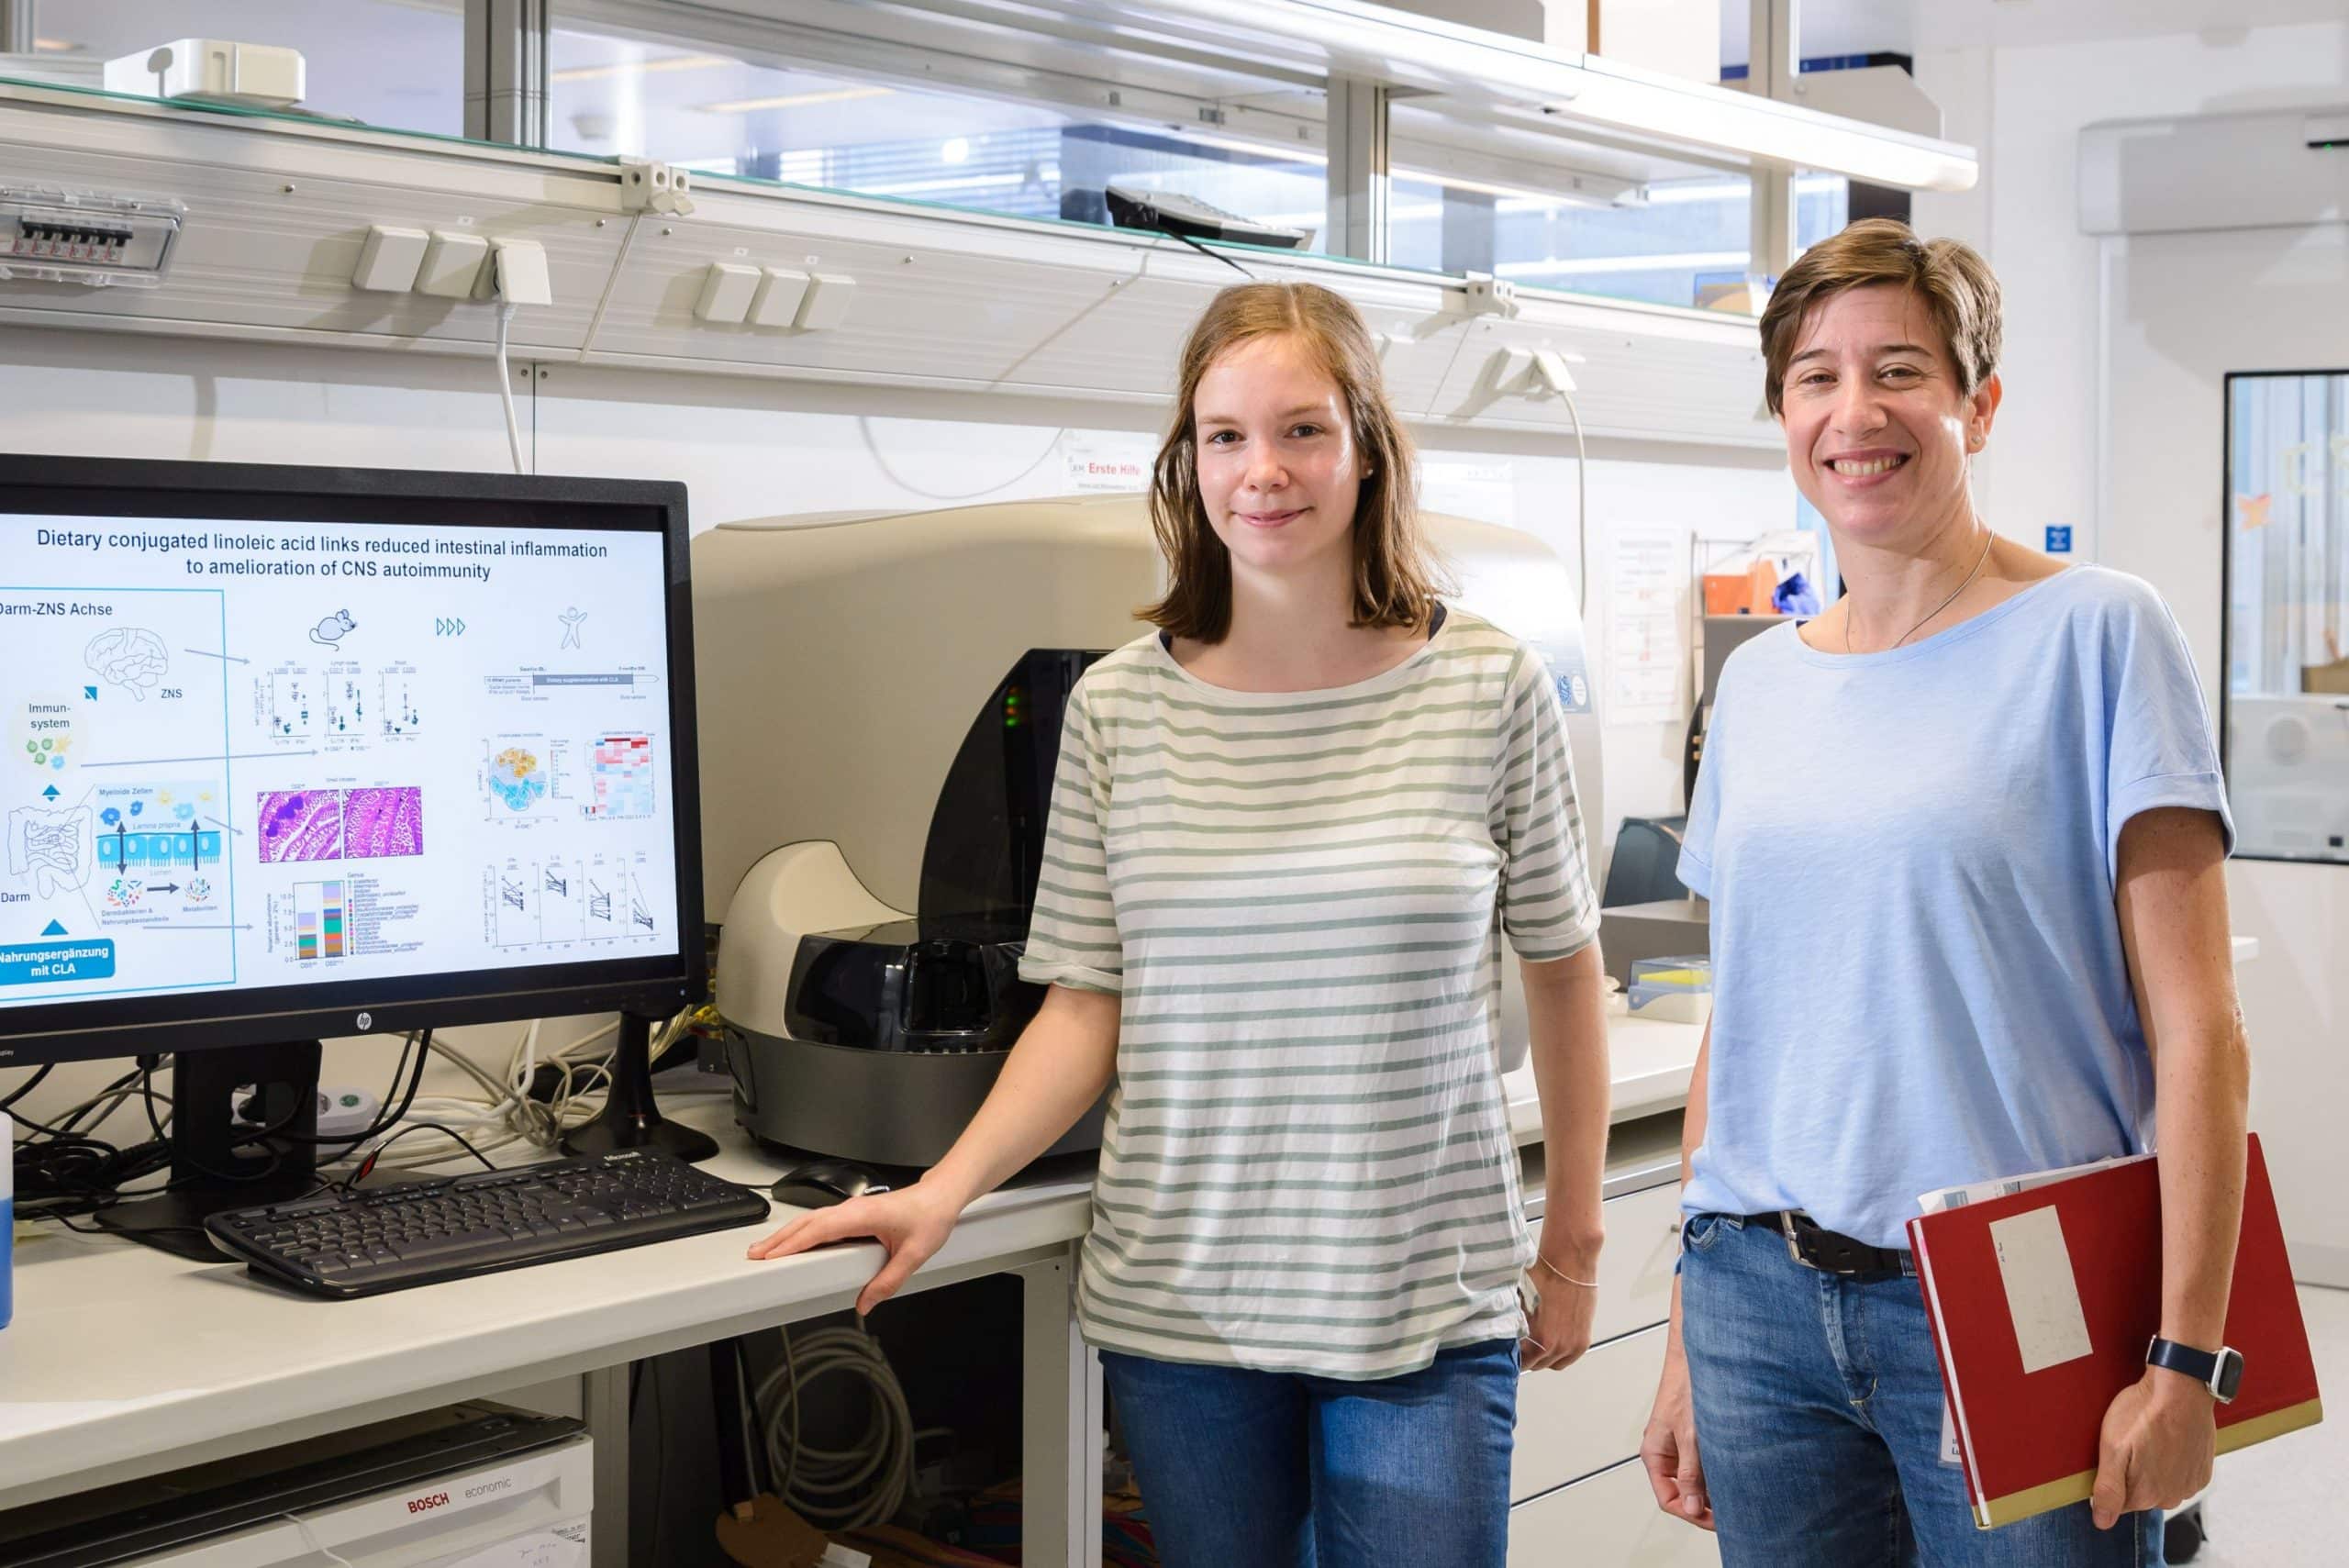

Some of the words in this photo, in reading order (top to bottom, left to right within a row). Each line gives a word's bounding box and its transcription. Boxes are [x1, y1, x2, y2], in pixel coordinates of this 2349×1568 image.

[1087, 462, 1117, 474] Erste
[38, 529, 102, 550] Dietary
[108, 531, 207, 551] conjugated
[214, 533, 275, 550] linoleic
[281, 536, 315, 550] acid
[321, 536, 360, 551] links
[365, 538, 429, 553] reduced
[435, 539, 506, 555] intestinal
[511, 540, 607, 557] inflammation
[186, 559, 203, 573] to
[209, 559, 315, 575] amelioration
[321, 561, 337, 575] of
[342, 561, 377, 576] CNS
[383, 562, 491, 582] autoimmunity
[70, 602, 112, 616] Achse
[161, 688, 183, 699] ZNS
[28, 703, 71, 713] Immun-
[30, 718, 70, 731] system
[1, 892, 30, 903] Darm
[31, 965, 50, 977] mit
[51, 962, 76, 975] CLA
[358, 1013, 371, 1029] hp
[406, 1492, 450, 1514] BOSCH
[464, 1476, 513, 1498] economic
